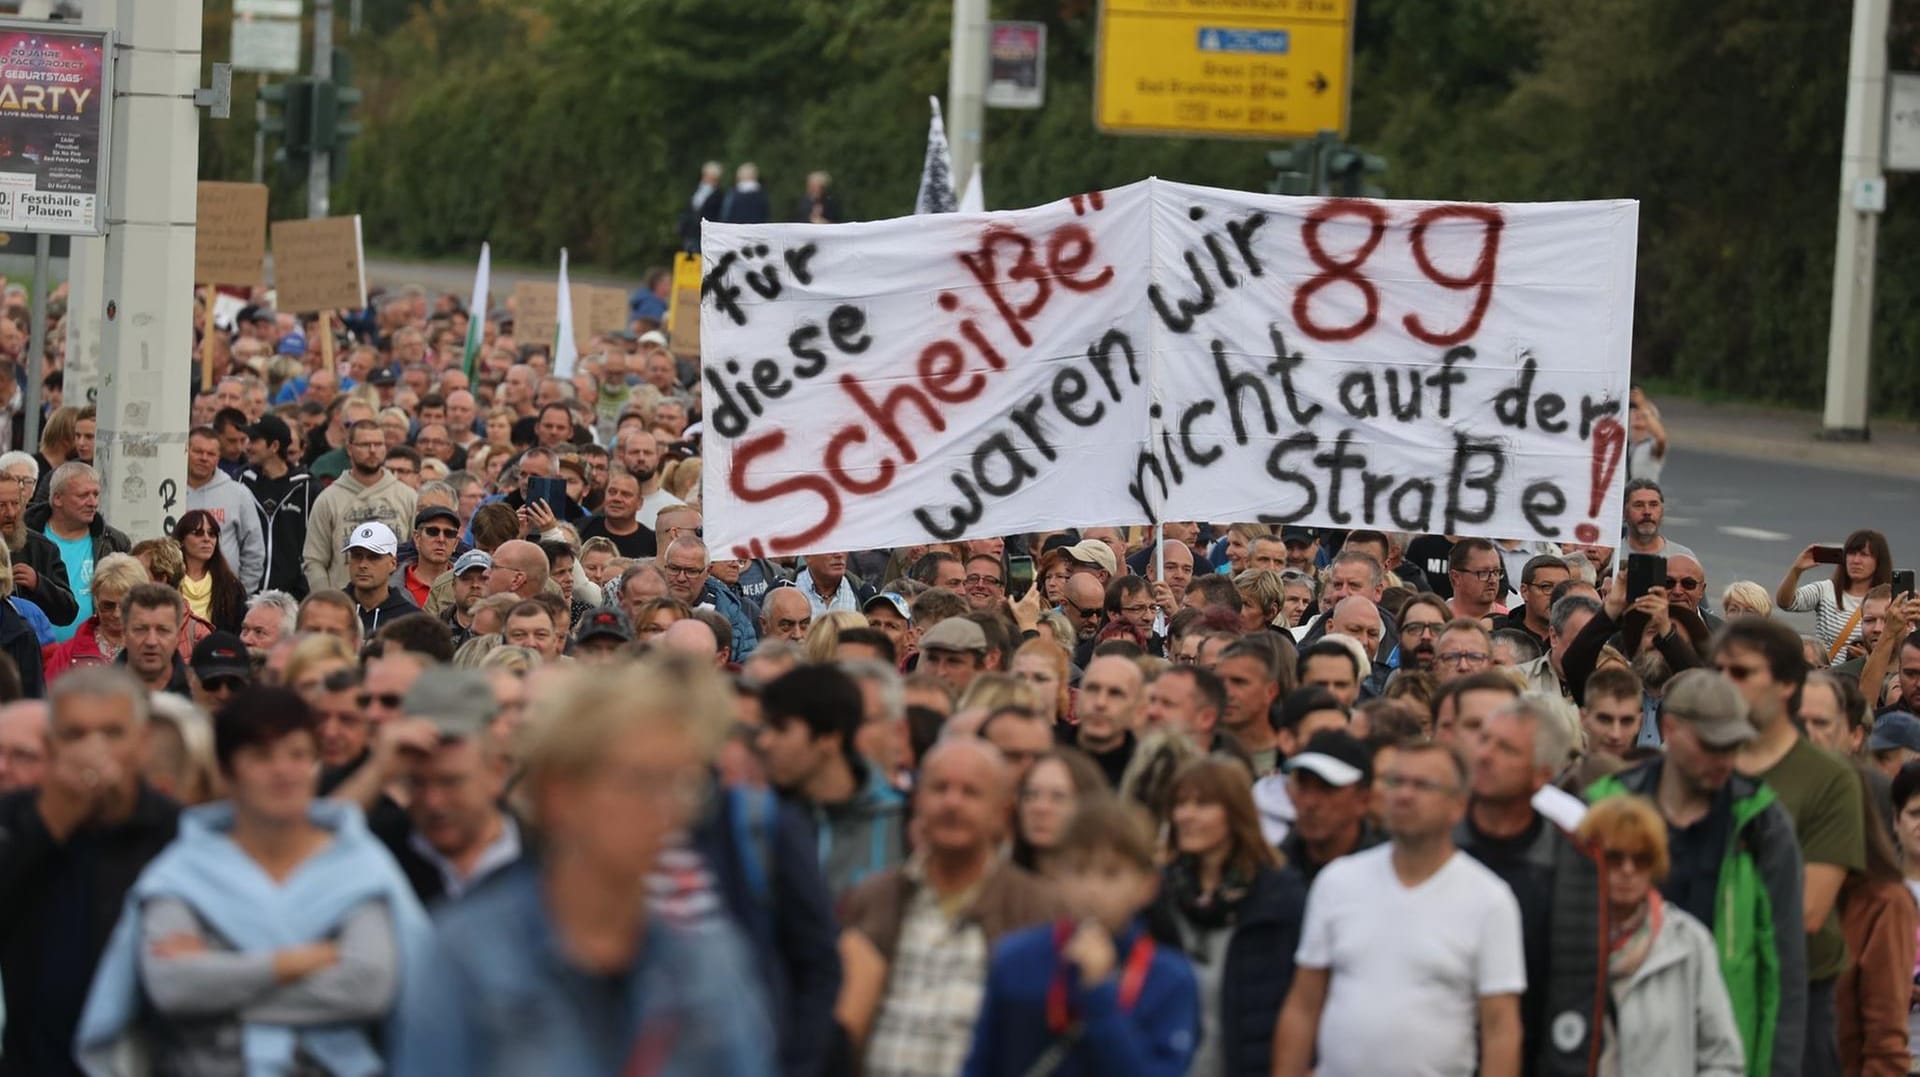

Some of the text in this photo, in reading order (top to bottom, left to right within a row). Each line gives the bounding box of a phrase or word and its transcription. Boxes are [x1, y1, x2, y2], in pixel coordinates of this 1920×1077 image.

[0, 83, 92, 113] ARTY
[21, 193, 81, 207] Festhalle
[27, 204, 72, 218] Plauen
[704, 304, 873, 439] diese
[913, 198, 1505, 541] waren wir 89
[1128, 321, 1621, 524] nicht auf der
